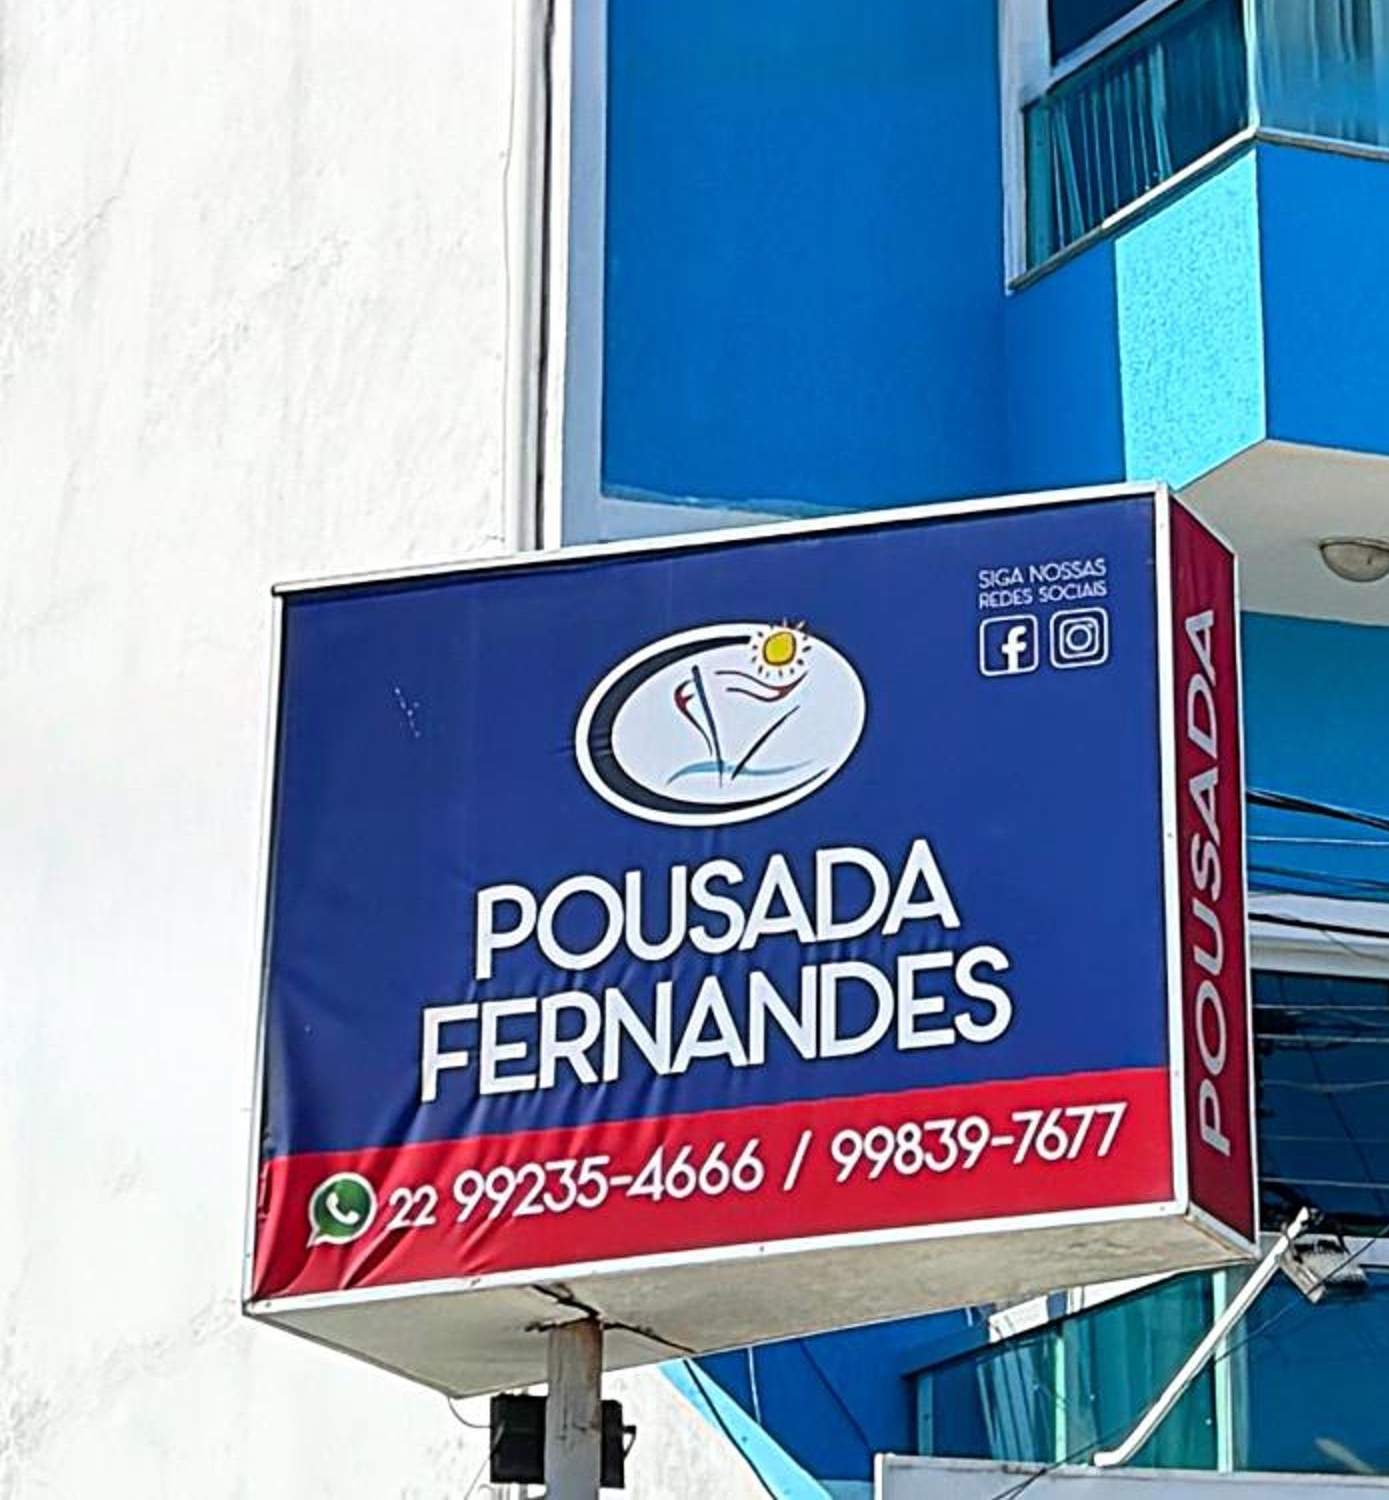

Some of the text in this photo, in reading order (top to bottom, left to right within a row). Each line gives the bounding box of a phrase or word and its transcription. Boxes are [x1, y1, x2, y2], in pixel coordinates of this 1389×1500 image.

[979, 557, 1106, 589] SIGA NOSSAS
[979, 580, 1107, 610] REDES SOCIAIS
[475, 838, 961, 980] POUSADA
[1184, 609, 1231, 1156] POUSADA
[420, 945, 1013, 1102] FERNANDES
[388, 1186, 437, 1230] 22
[452, 1138, 765, 1225] 99235-4666
[830, 1102, 1128, 1183] 99839-7677
